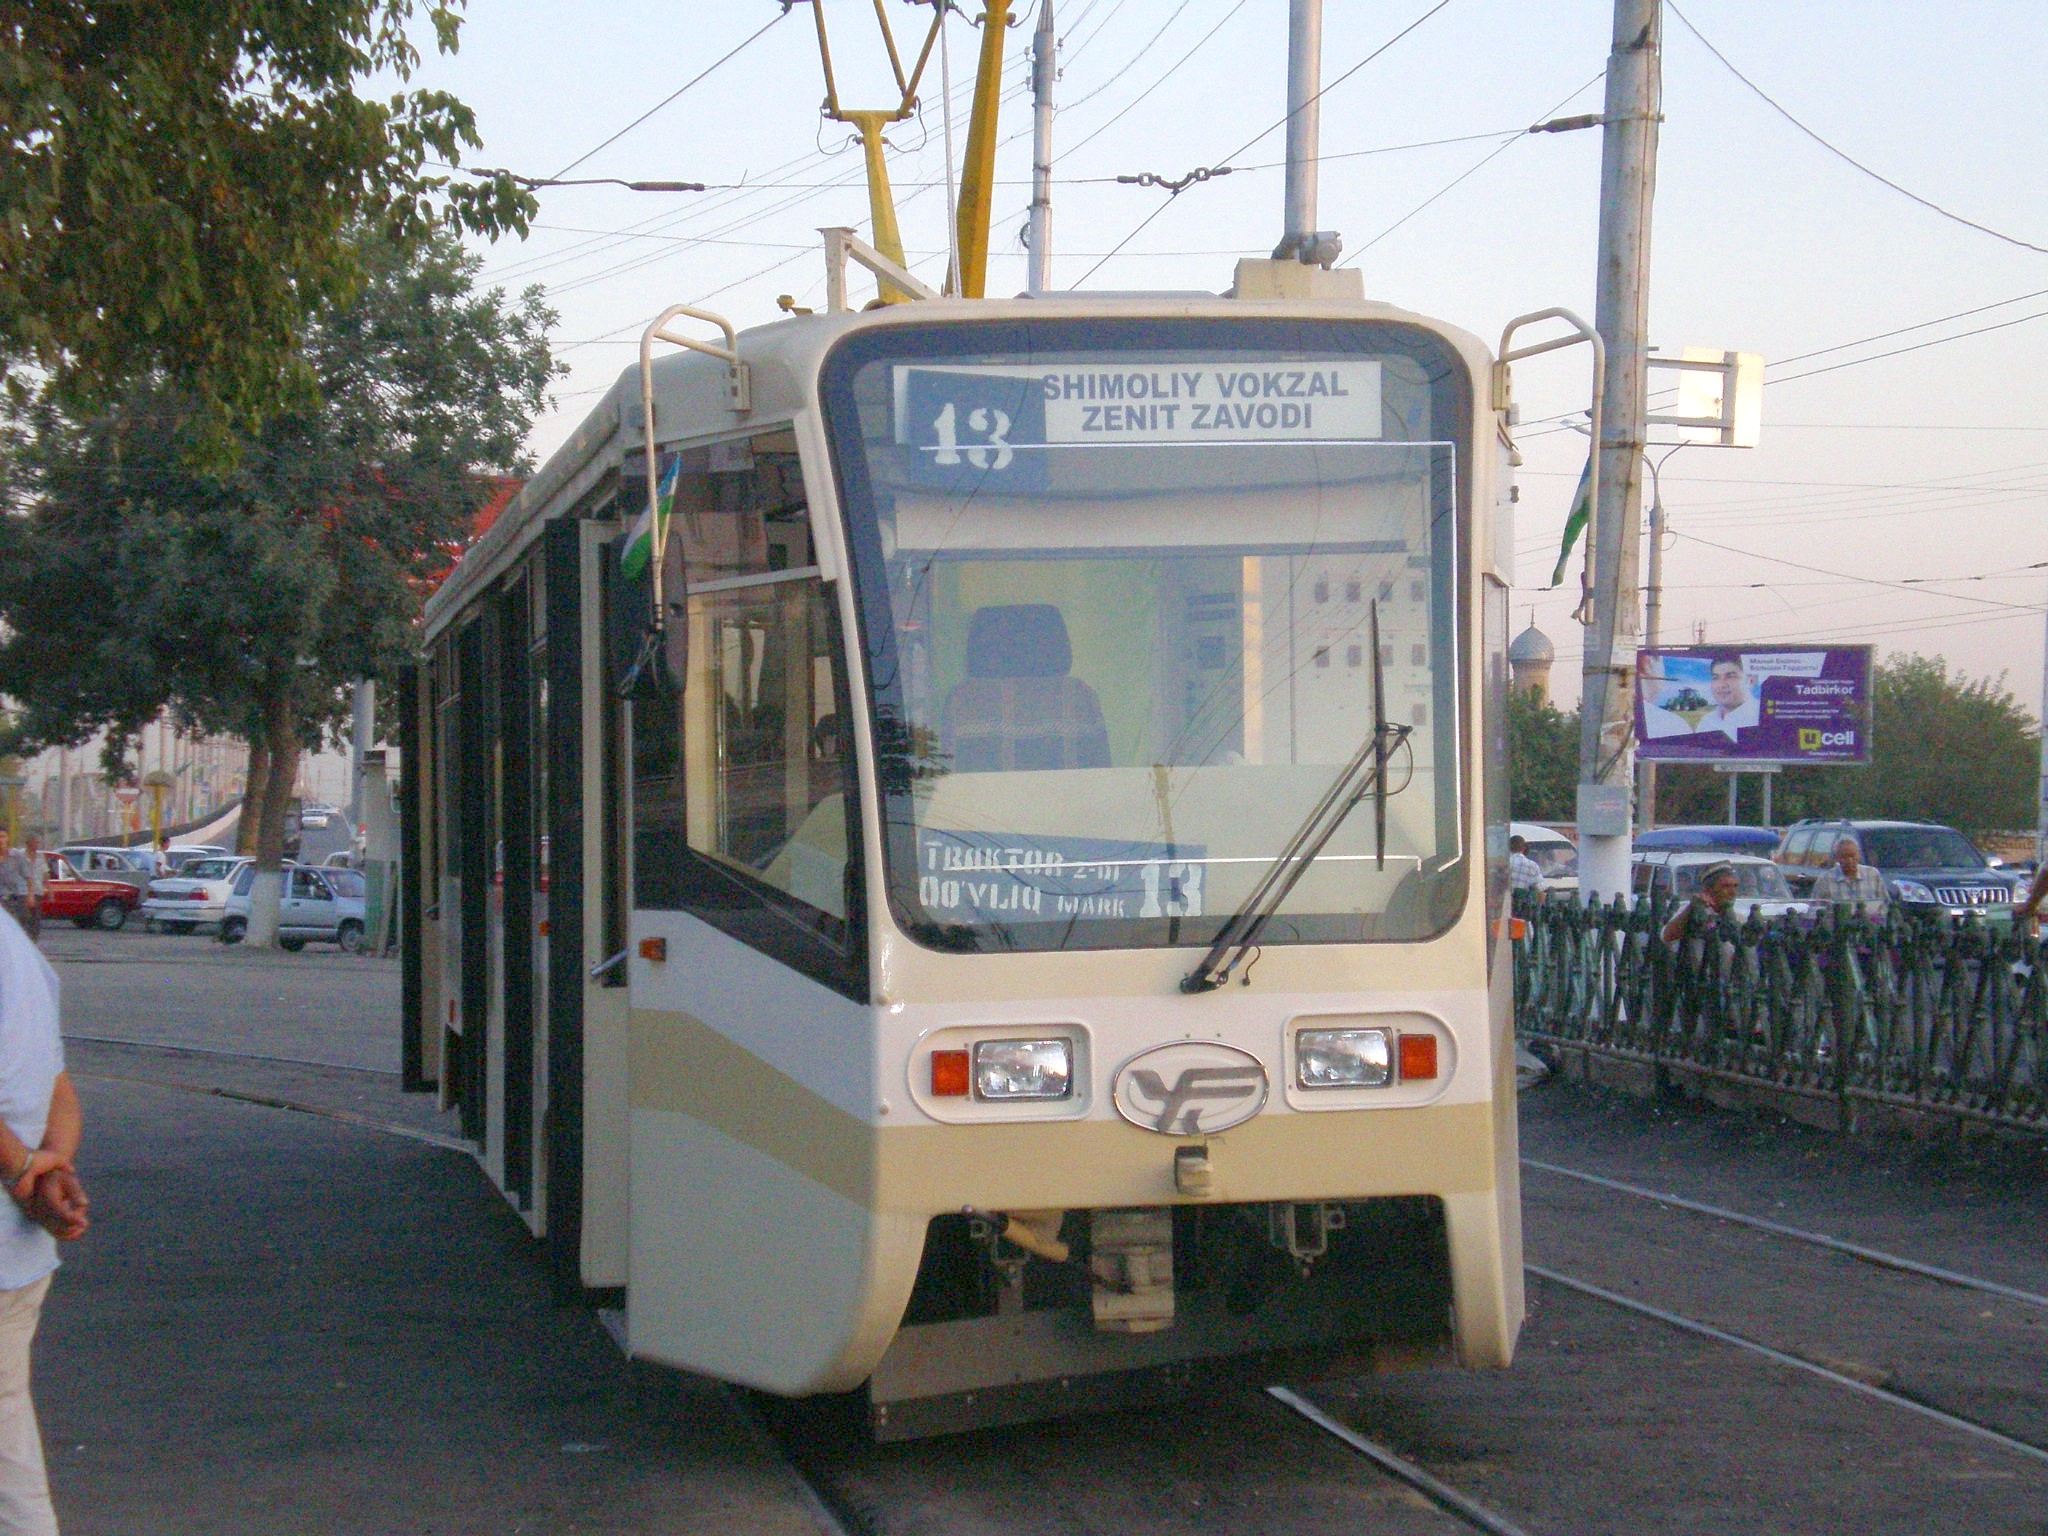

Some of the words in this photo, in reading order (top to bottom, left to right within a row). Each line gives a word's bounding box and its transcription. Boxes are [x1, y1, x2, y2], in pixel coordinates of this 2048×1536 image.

[1042, 371, 1203, 401] SHIMOLIY
[1216, 370, 1349, 398] VOKZAL
[1081, 403, 1181, 432] ZENIT
[1191, 402, 1313, 430] ZAVODI
[934, 401, 1014, 470] 13
[1795, 684, 1855, 696] Tadbirkor
[1139, 858, 1203, 917] 13
